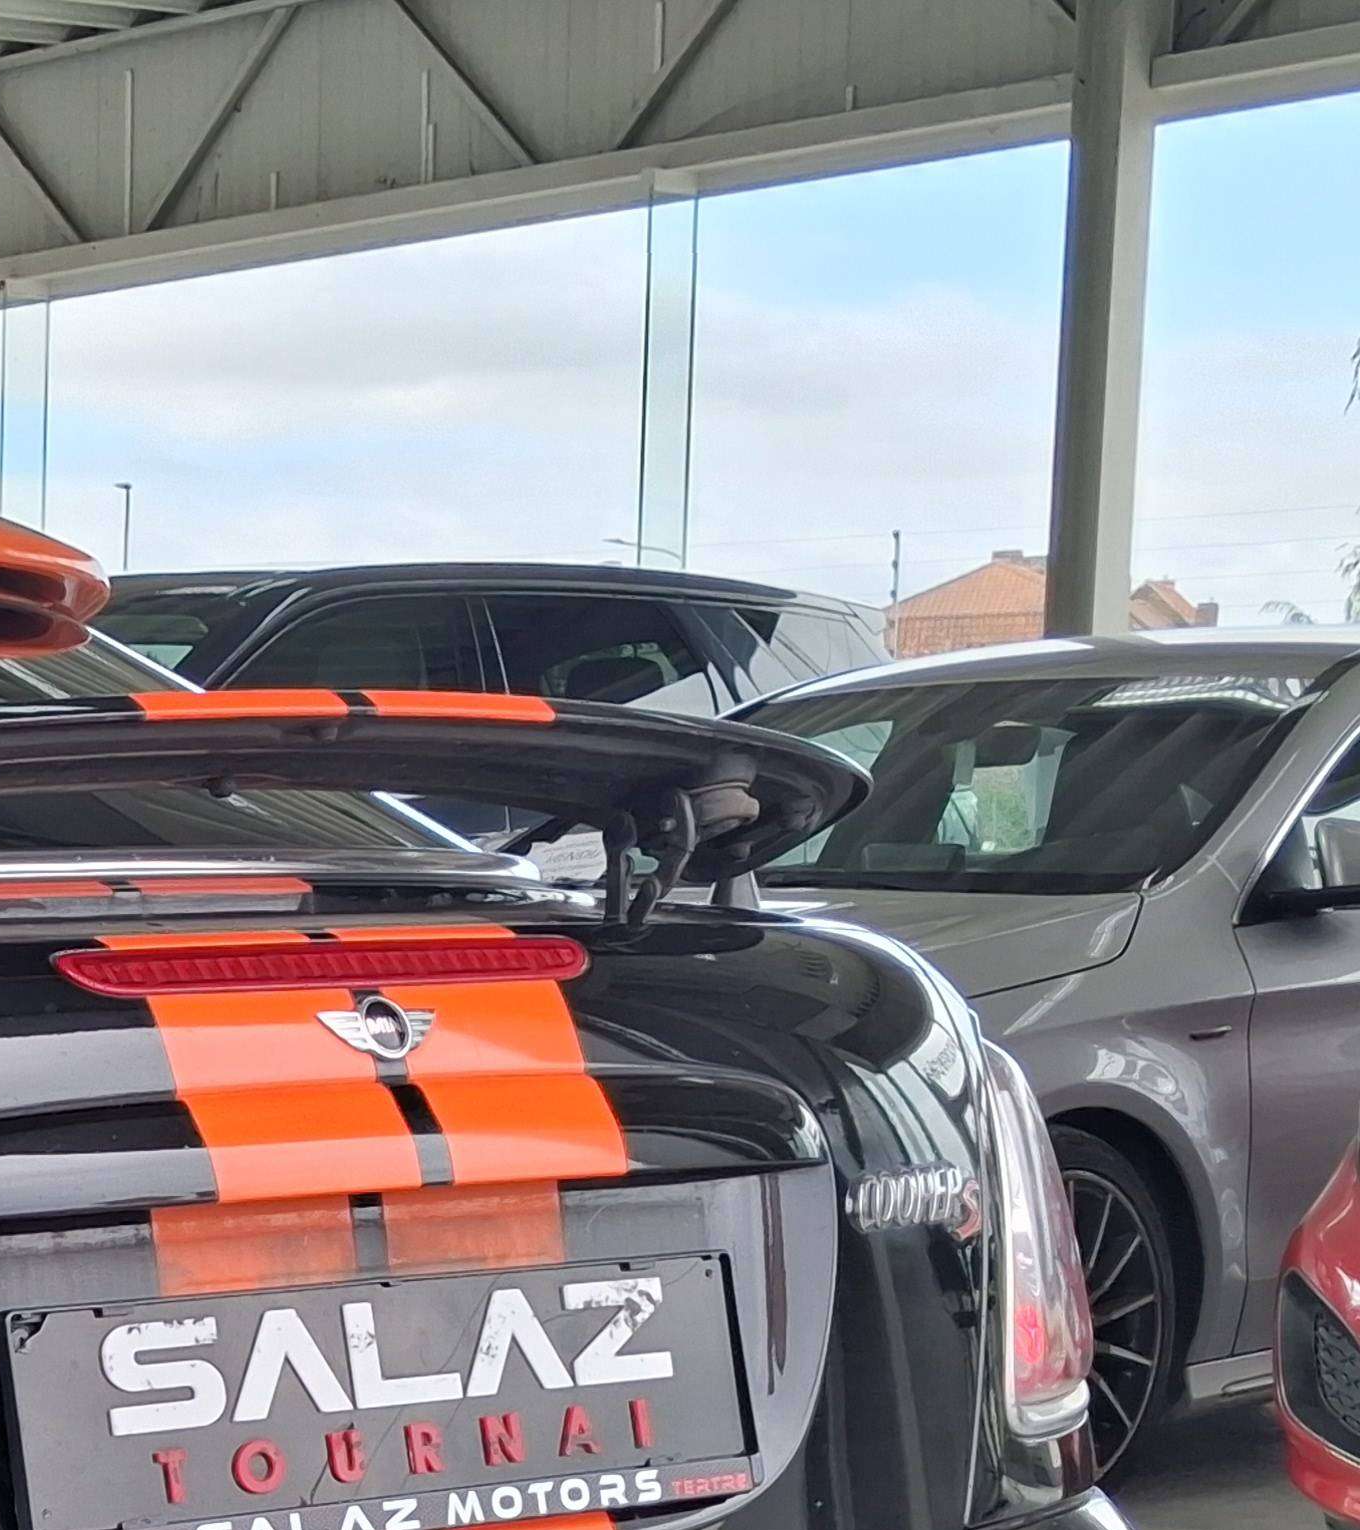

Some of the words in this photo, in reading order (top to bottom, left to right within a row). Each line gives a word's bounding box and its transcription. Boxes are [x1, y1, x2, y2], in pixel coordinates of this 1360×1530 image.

[102, 1276, 674, 1437] SALAZ
[152, 1399, 654, 1505] TOURNAI
[447, 1469, 663, 1525] MOTORS
[671, 1472, 749, 1495] TERTRE
